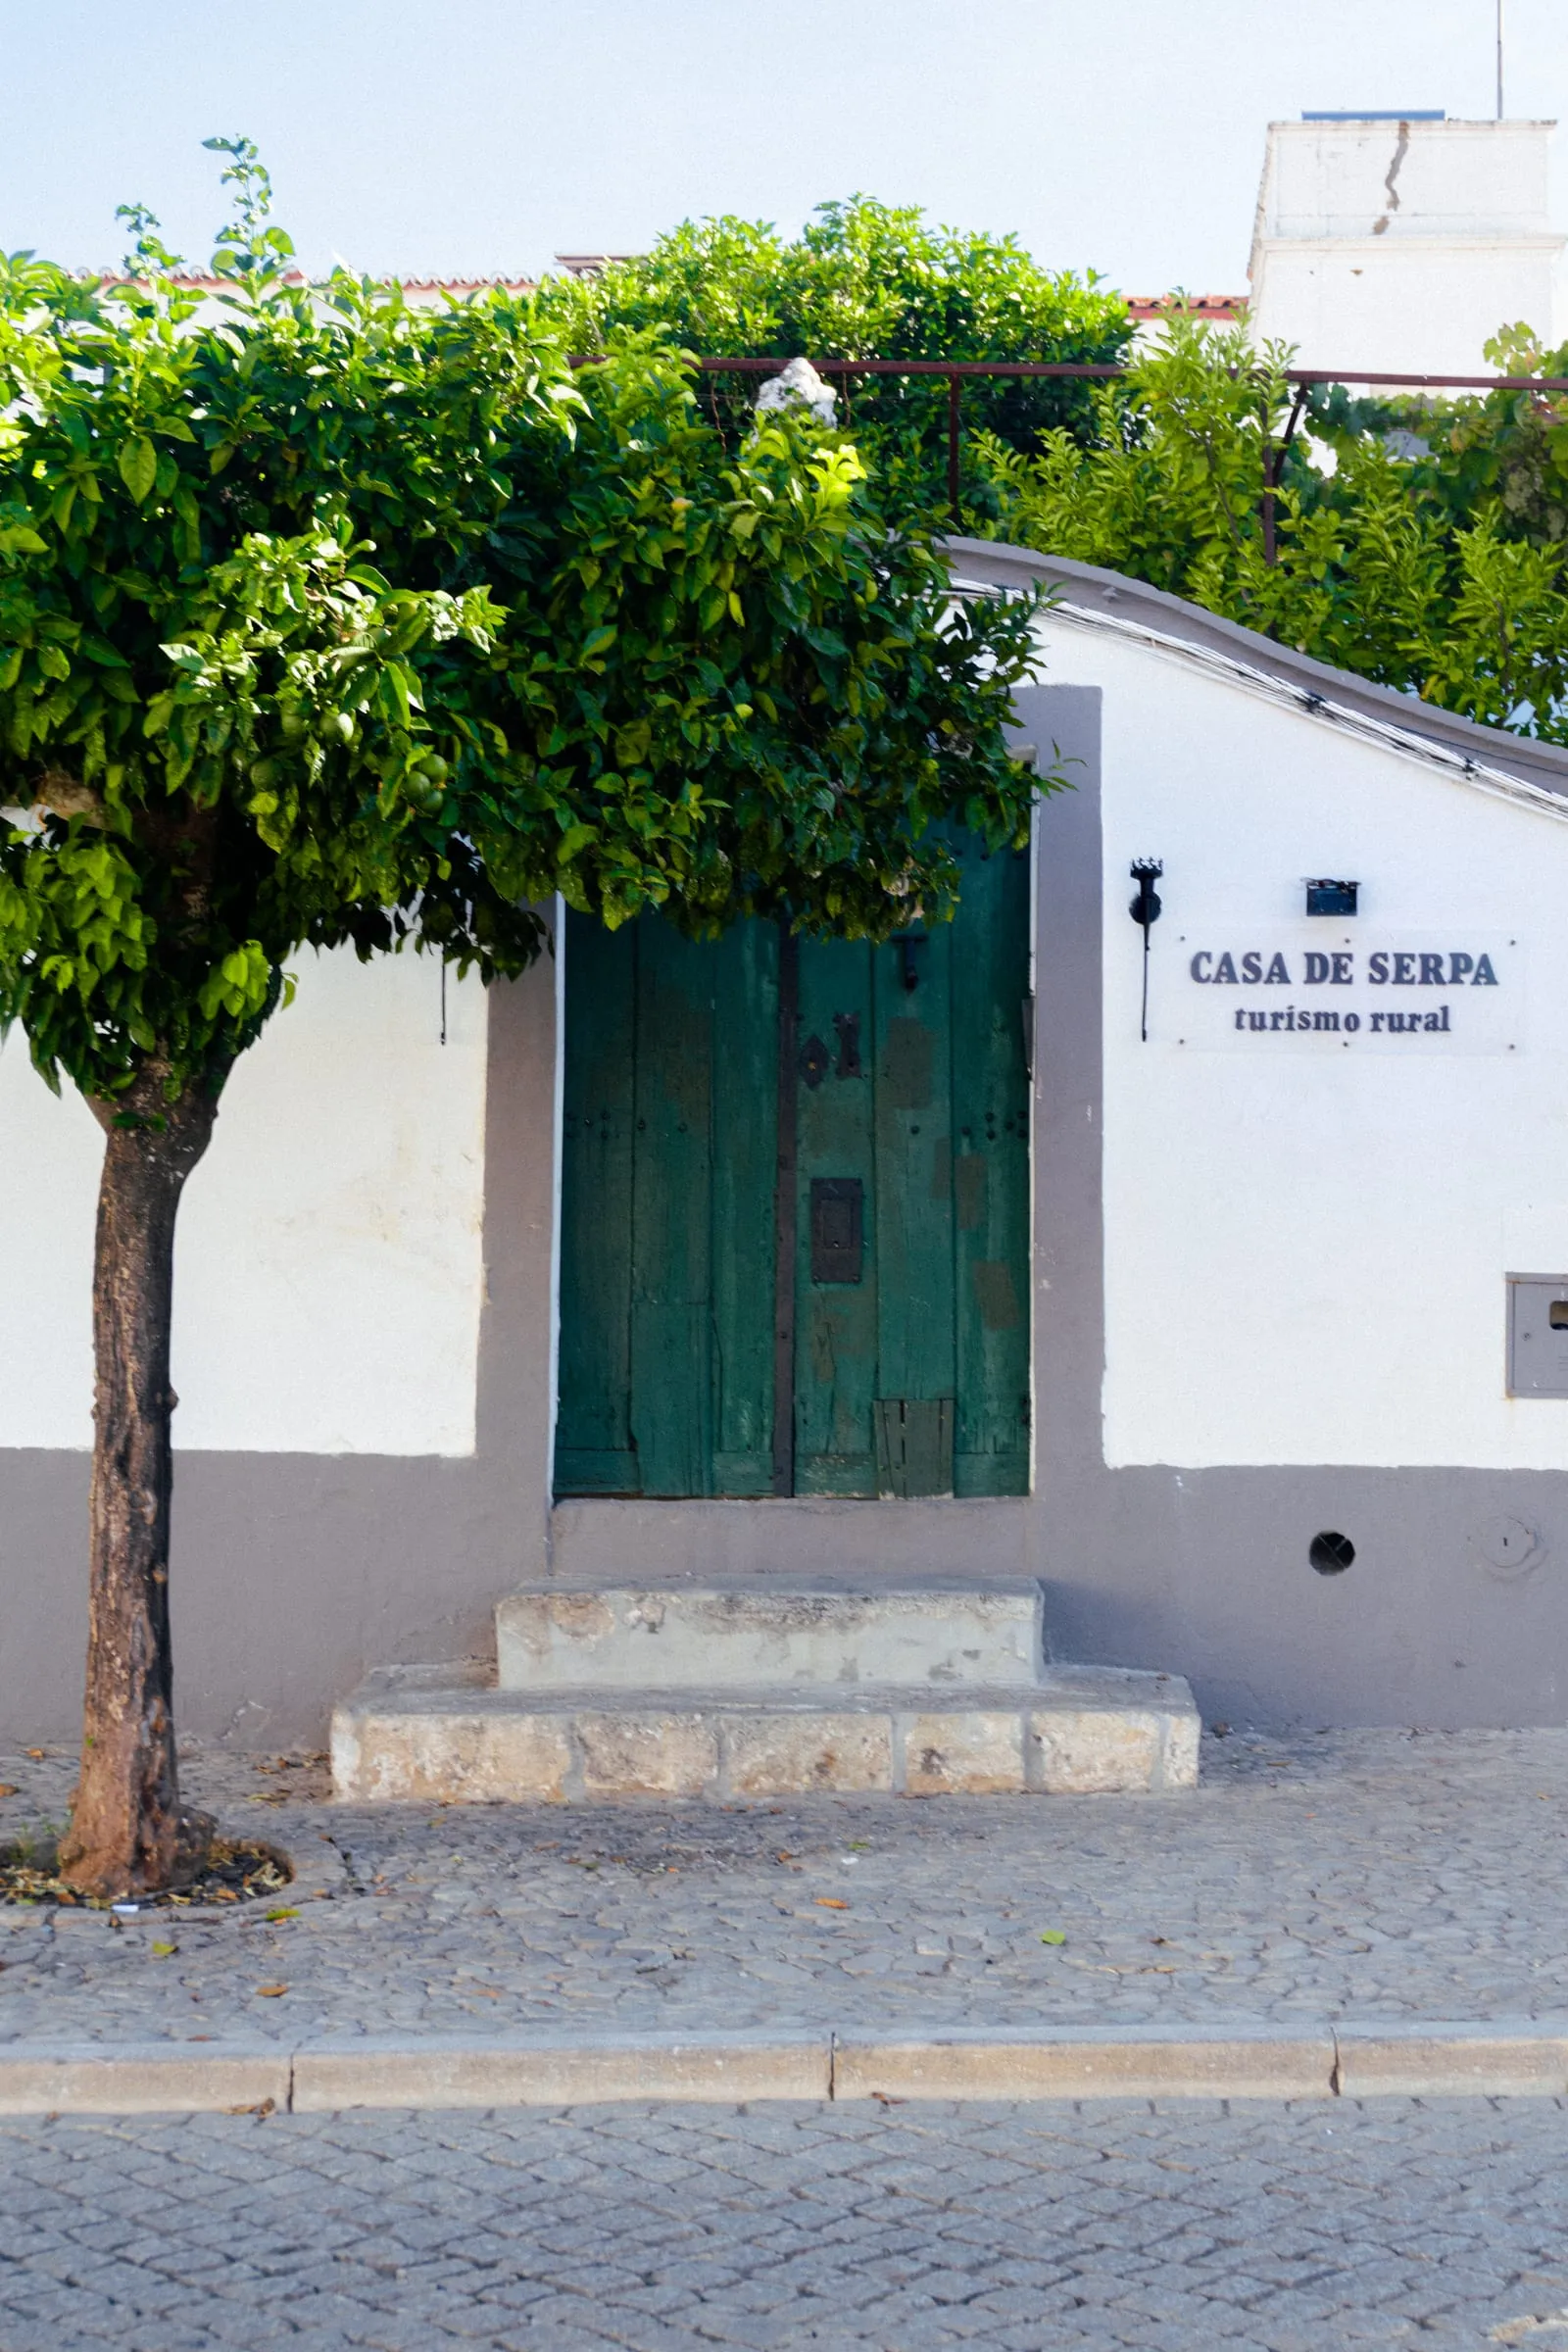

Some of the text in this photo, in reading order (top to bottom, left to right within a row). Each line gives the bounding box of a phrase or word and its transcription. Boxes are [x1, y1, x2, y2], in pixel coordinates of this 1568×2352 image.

[1190, 951, 1499, 987] CASA DE SERPA
[1234, 1004, 1451, 1034] turismo rural
